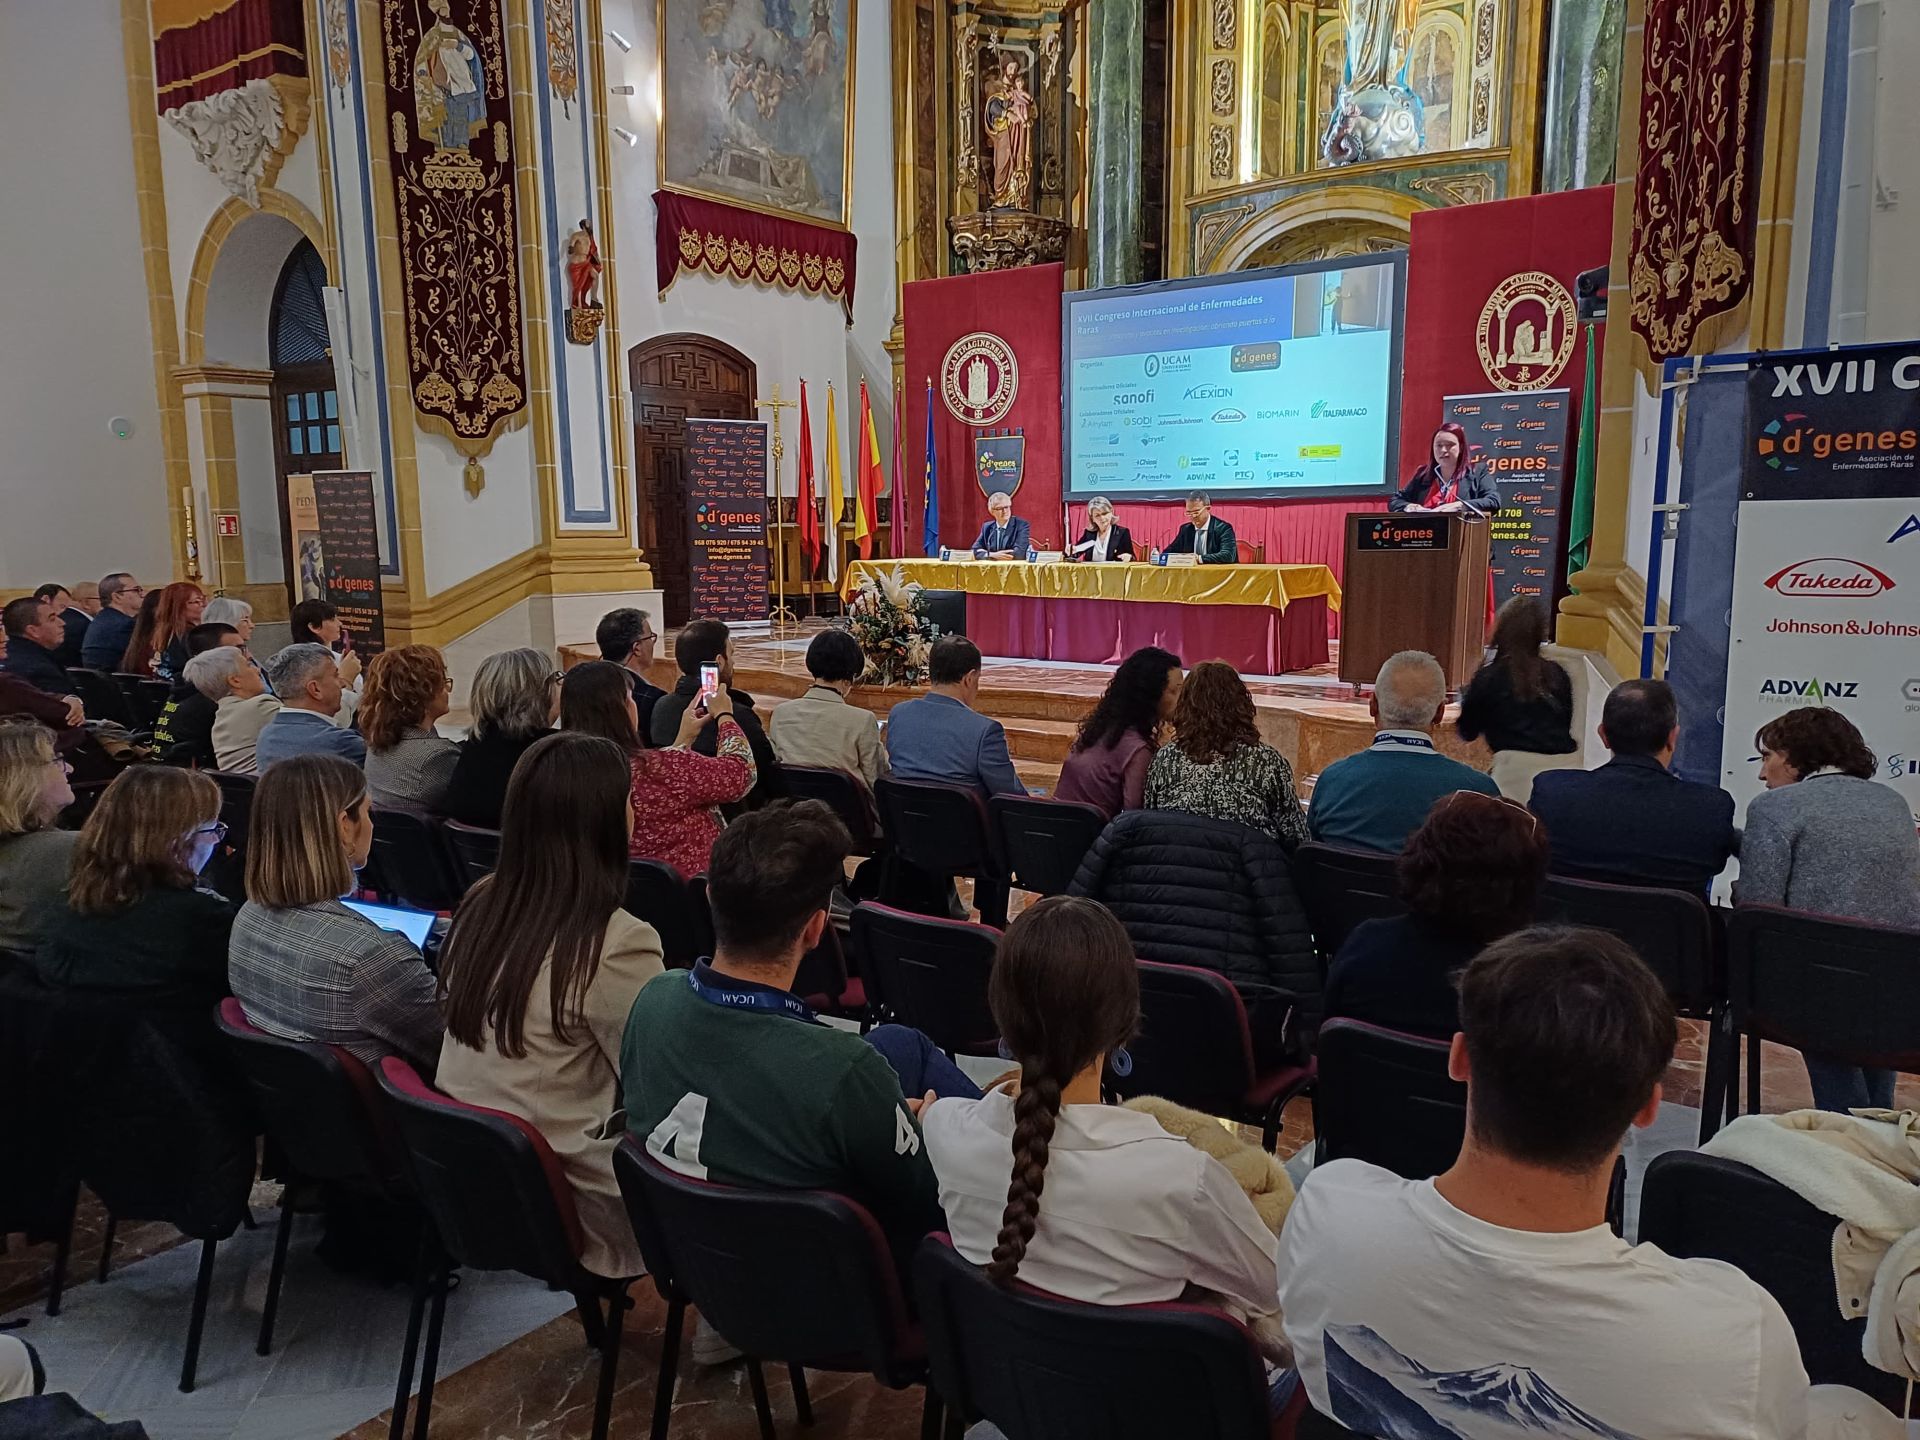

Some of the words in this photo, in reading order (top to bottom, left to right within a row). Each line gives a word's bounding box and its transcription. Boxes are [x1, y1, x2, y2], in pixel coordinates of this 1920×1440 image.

[1094, 310, 1131, 323] Congreso
[1132, 303, 1187, 318] Internacional
[1188, 302, 1199, 311] de
[1201, 295, 1264, 310] Enfermedades
[1077, 326, 1099, 335] Raras
[1162, 354, 1191, 365] UCAM
[1771, 359, 1876, 398] XVII
[1113, 388, 1155, 405] sanofi
[1858, 454, 1902, 462] Asociación
[1832, 462, 1888, 470] Enfermedades
[1504, 509, 1522, 518] 708
[1788, 573, 1874, 589] Takeda
[1766, 618, 1920, 637] Johnson&Johns
[1760, 677, 1859, 704] ADVANZ
[1758, 695, 1813, 705] PHARMA
[722, 993, 755, 1004] UCAM
